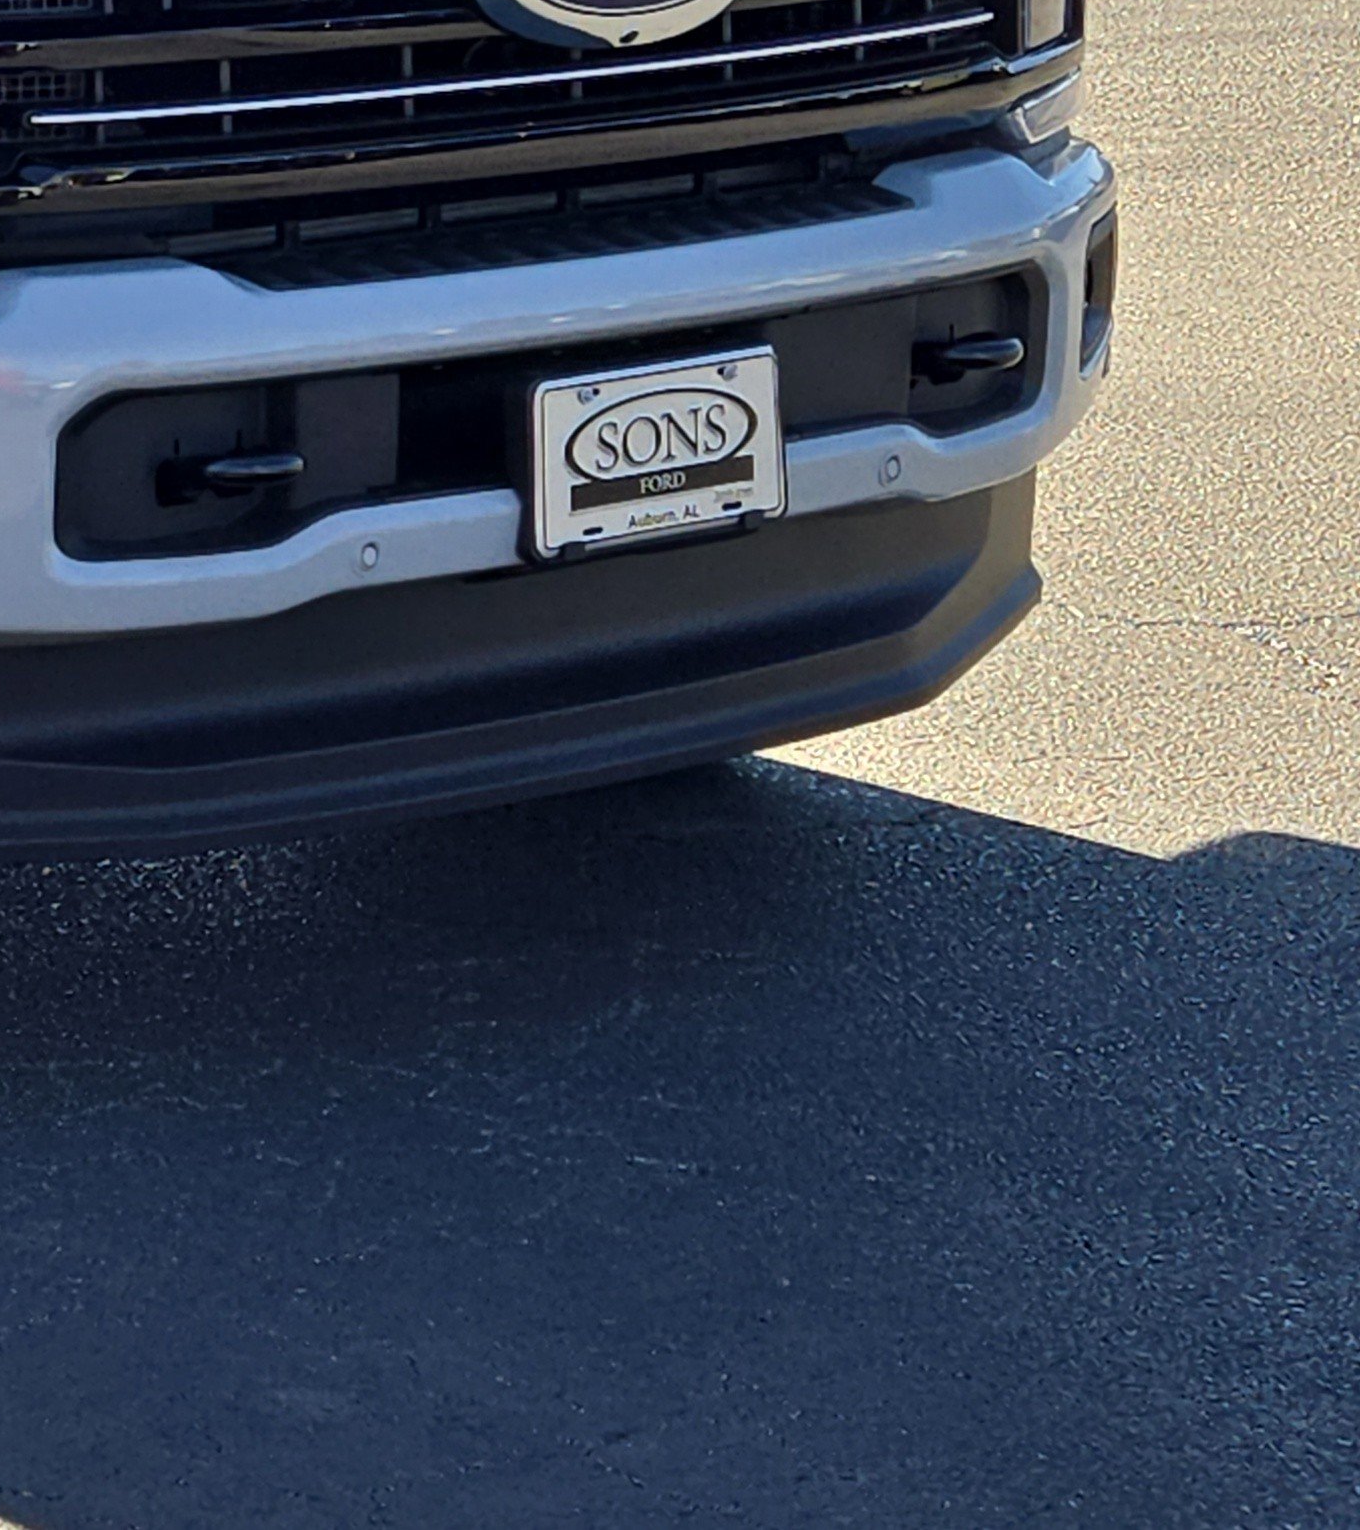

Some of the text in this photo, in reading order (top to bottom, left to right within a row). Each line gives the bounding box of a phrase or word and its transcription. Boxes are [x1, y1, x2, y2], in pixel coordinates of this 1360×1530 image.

[595, 403, 727, 472] SONS
[640, 471, 686, 494] FORD
[683, 504, 701, 520] AL
